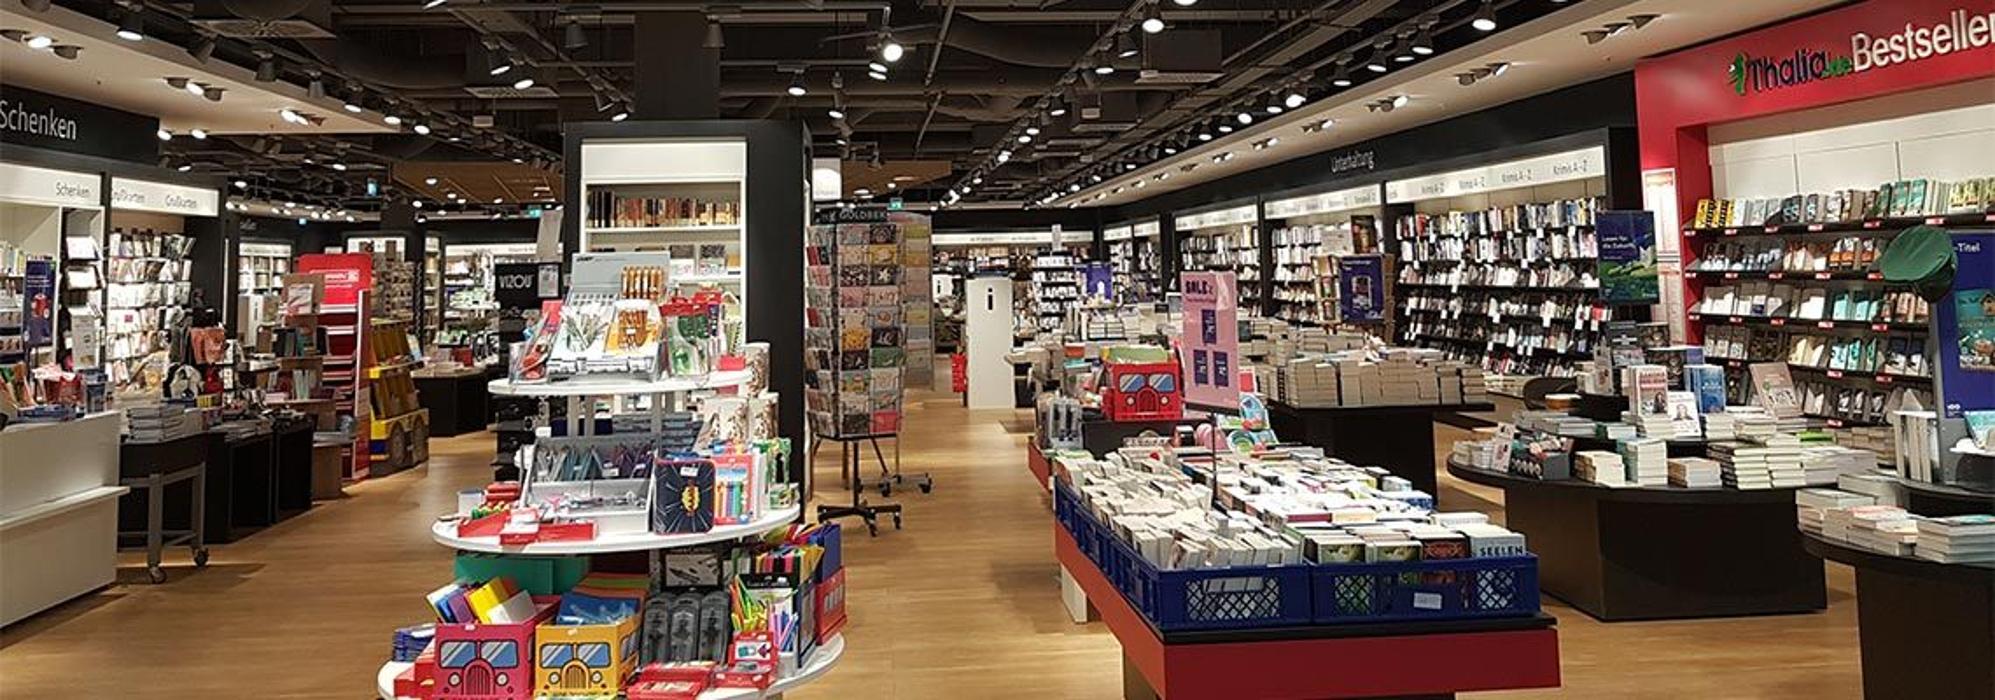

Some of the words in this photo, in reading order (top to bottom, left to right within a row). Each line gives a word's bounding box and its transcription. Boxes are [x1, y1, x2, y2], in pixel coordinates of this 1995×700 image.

[0, 99, 77, 141] Schenken
[1331, 149, 1375, 174] Unterhaltung
[56, 182, 91, 199] Schenken
[1480, 545, 1524, 557] SEELEN
